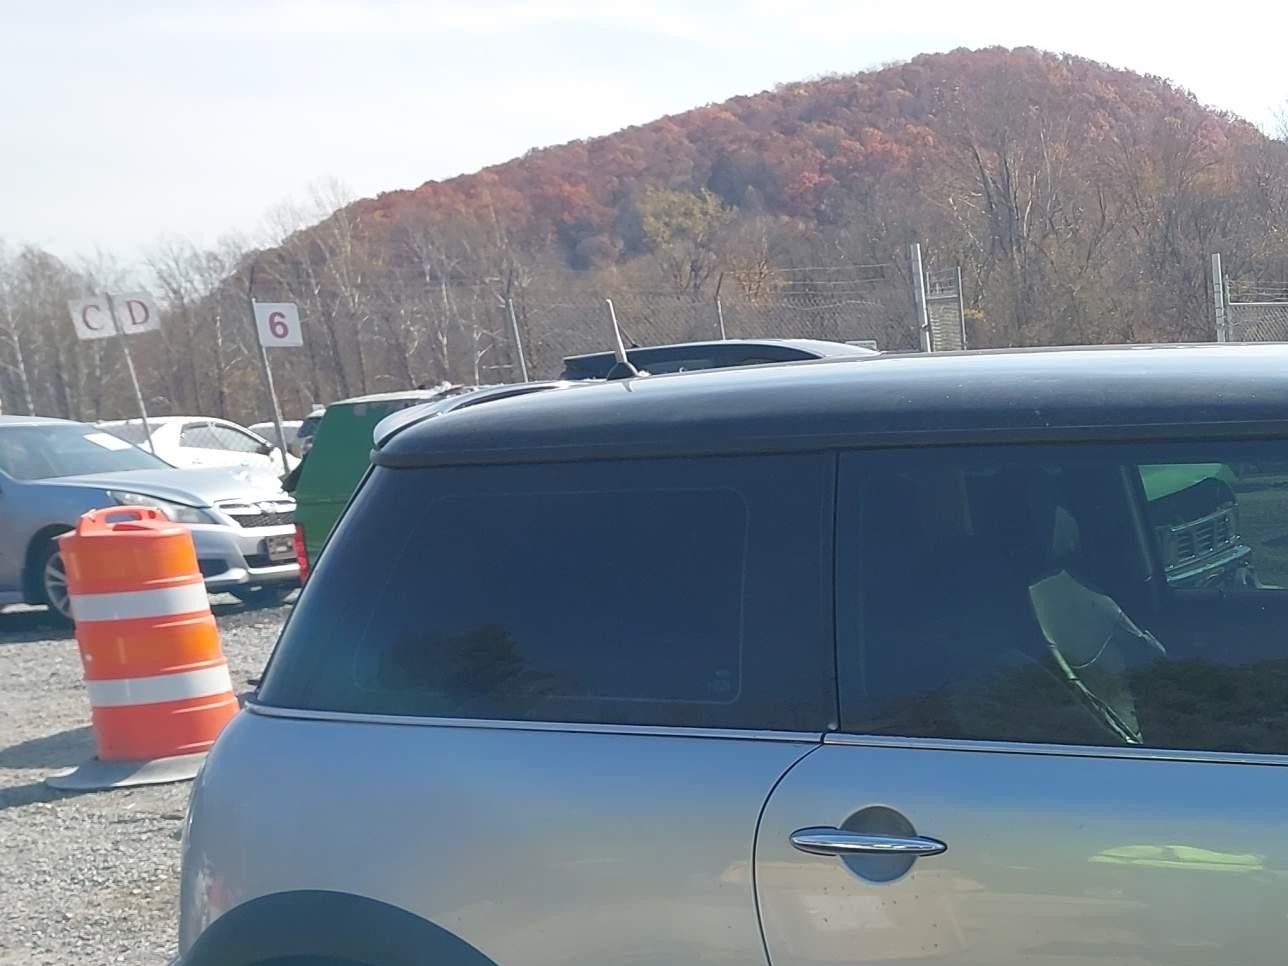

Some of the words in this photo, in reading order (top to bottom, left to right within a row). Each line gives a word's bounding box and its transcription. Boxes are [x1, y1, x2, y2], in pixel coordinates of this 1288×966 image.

[82, 304, 102, 331] C
[126, 299, 150, 326] D
[268, 311, 289, 339] 6
